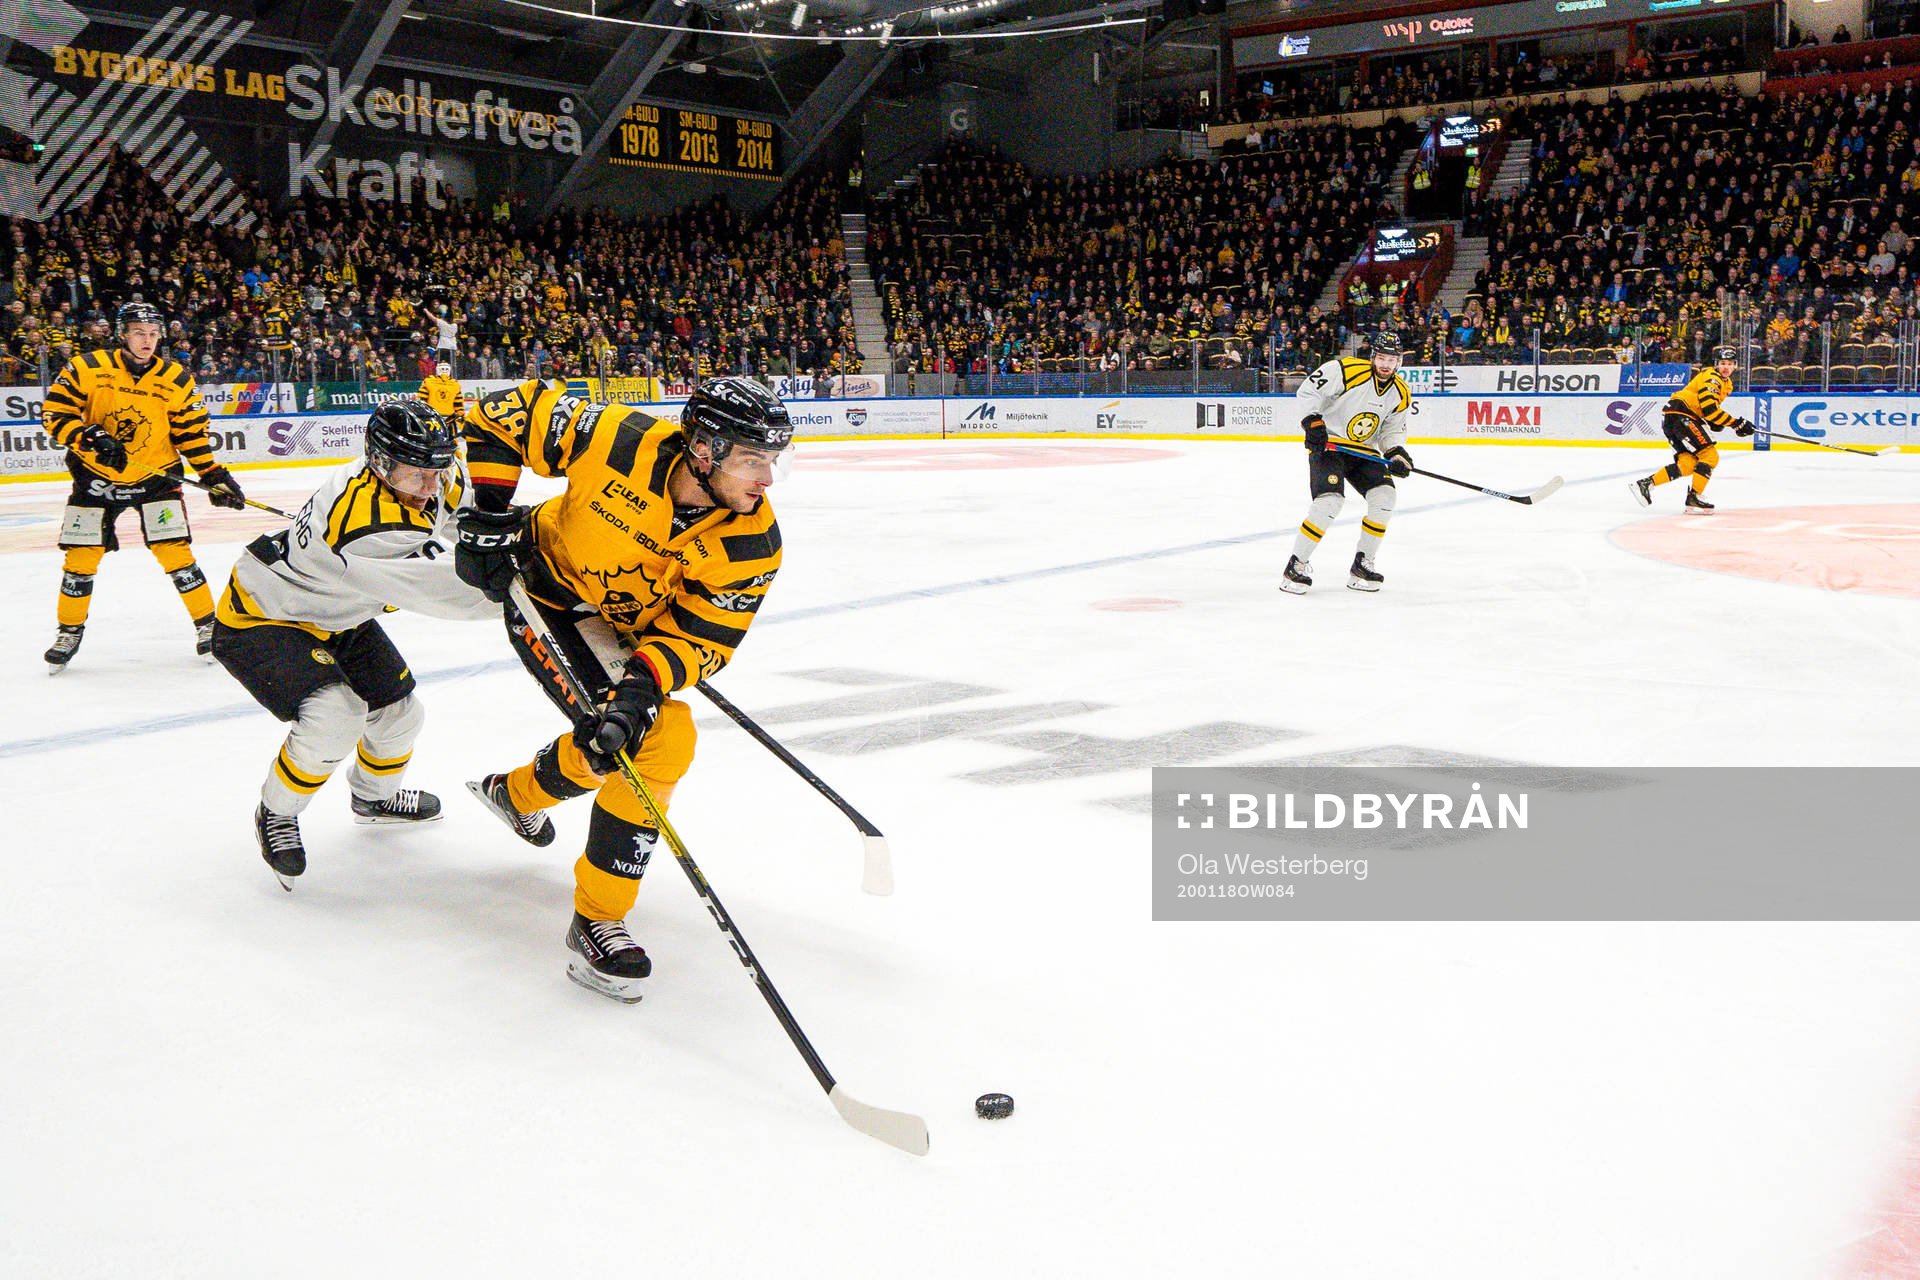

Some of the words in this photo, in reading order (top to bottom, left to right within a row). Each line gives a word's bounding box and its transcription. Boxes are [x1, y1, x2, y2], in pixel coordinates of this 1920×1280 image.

[1383, 21, 1422, 42] wsp
[1430, 17, 1473, 30] Outotec
[53, 46, 216, 93] BYGDENS
[224, 68, 285, 101] LAG
[285, 64, 583, 156] Skellefteå
[374, 91, 469, 124] NORTH
[474, 105, 559, 133] POWER
[622, 105, 660, 124] M-GULD
[679, 110, 718, 132] SM-GULD
[736, 119, 773, 139] SM-GULD
[620, 123, 660, 158] 1978
[679, 130, 720, 164] 2013
[737, 138, 774, 171] 2014
[288, 142, 447, 210] Kraft
[1308, 370, 1329, 390] 24
[1496, 370, 1600, 392] Henson
[237, 390, 290, 403] Måleri
[791, 413, 833, 426] anken
[1006, 412, 1049, 422] Miljöteknik
[1231, 406, 1273, 415] FORDONS
[1231, 416, 1273, 425] MONTAGE
[1467, 401, 1541, 426] MAXI
[321, 425, 368, 436] Skellefte
[698, 415, 721, 431] CCM
[1096, 413, 1117, 429] EY
[1480, 426, 1541, 434] STORMARKNAD
[322, 437, 350, 448] Kraft
[620, 486, 648, 511] LEAB
[588, 500, 631, 534] ŠKODA
[671, 516, 687, 530] SHL
[458, 528, 524, 548] CCM
